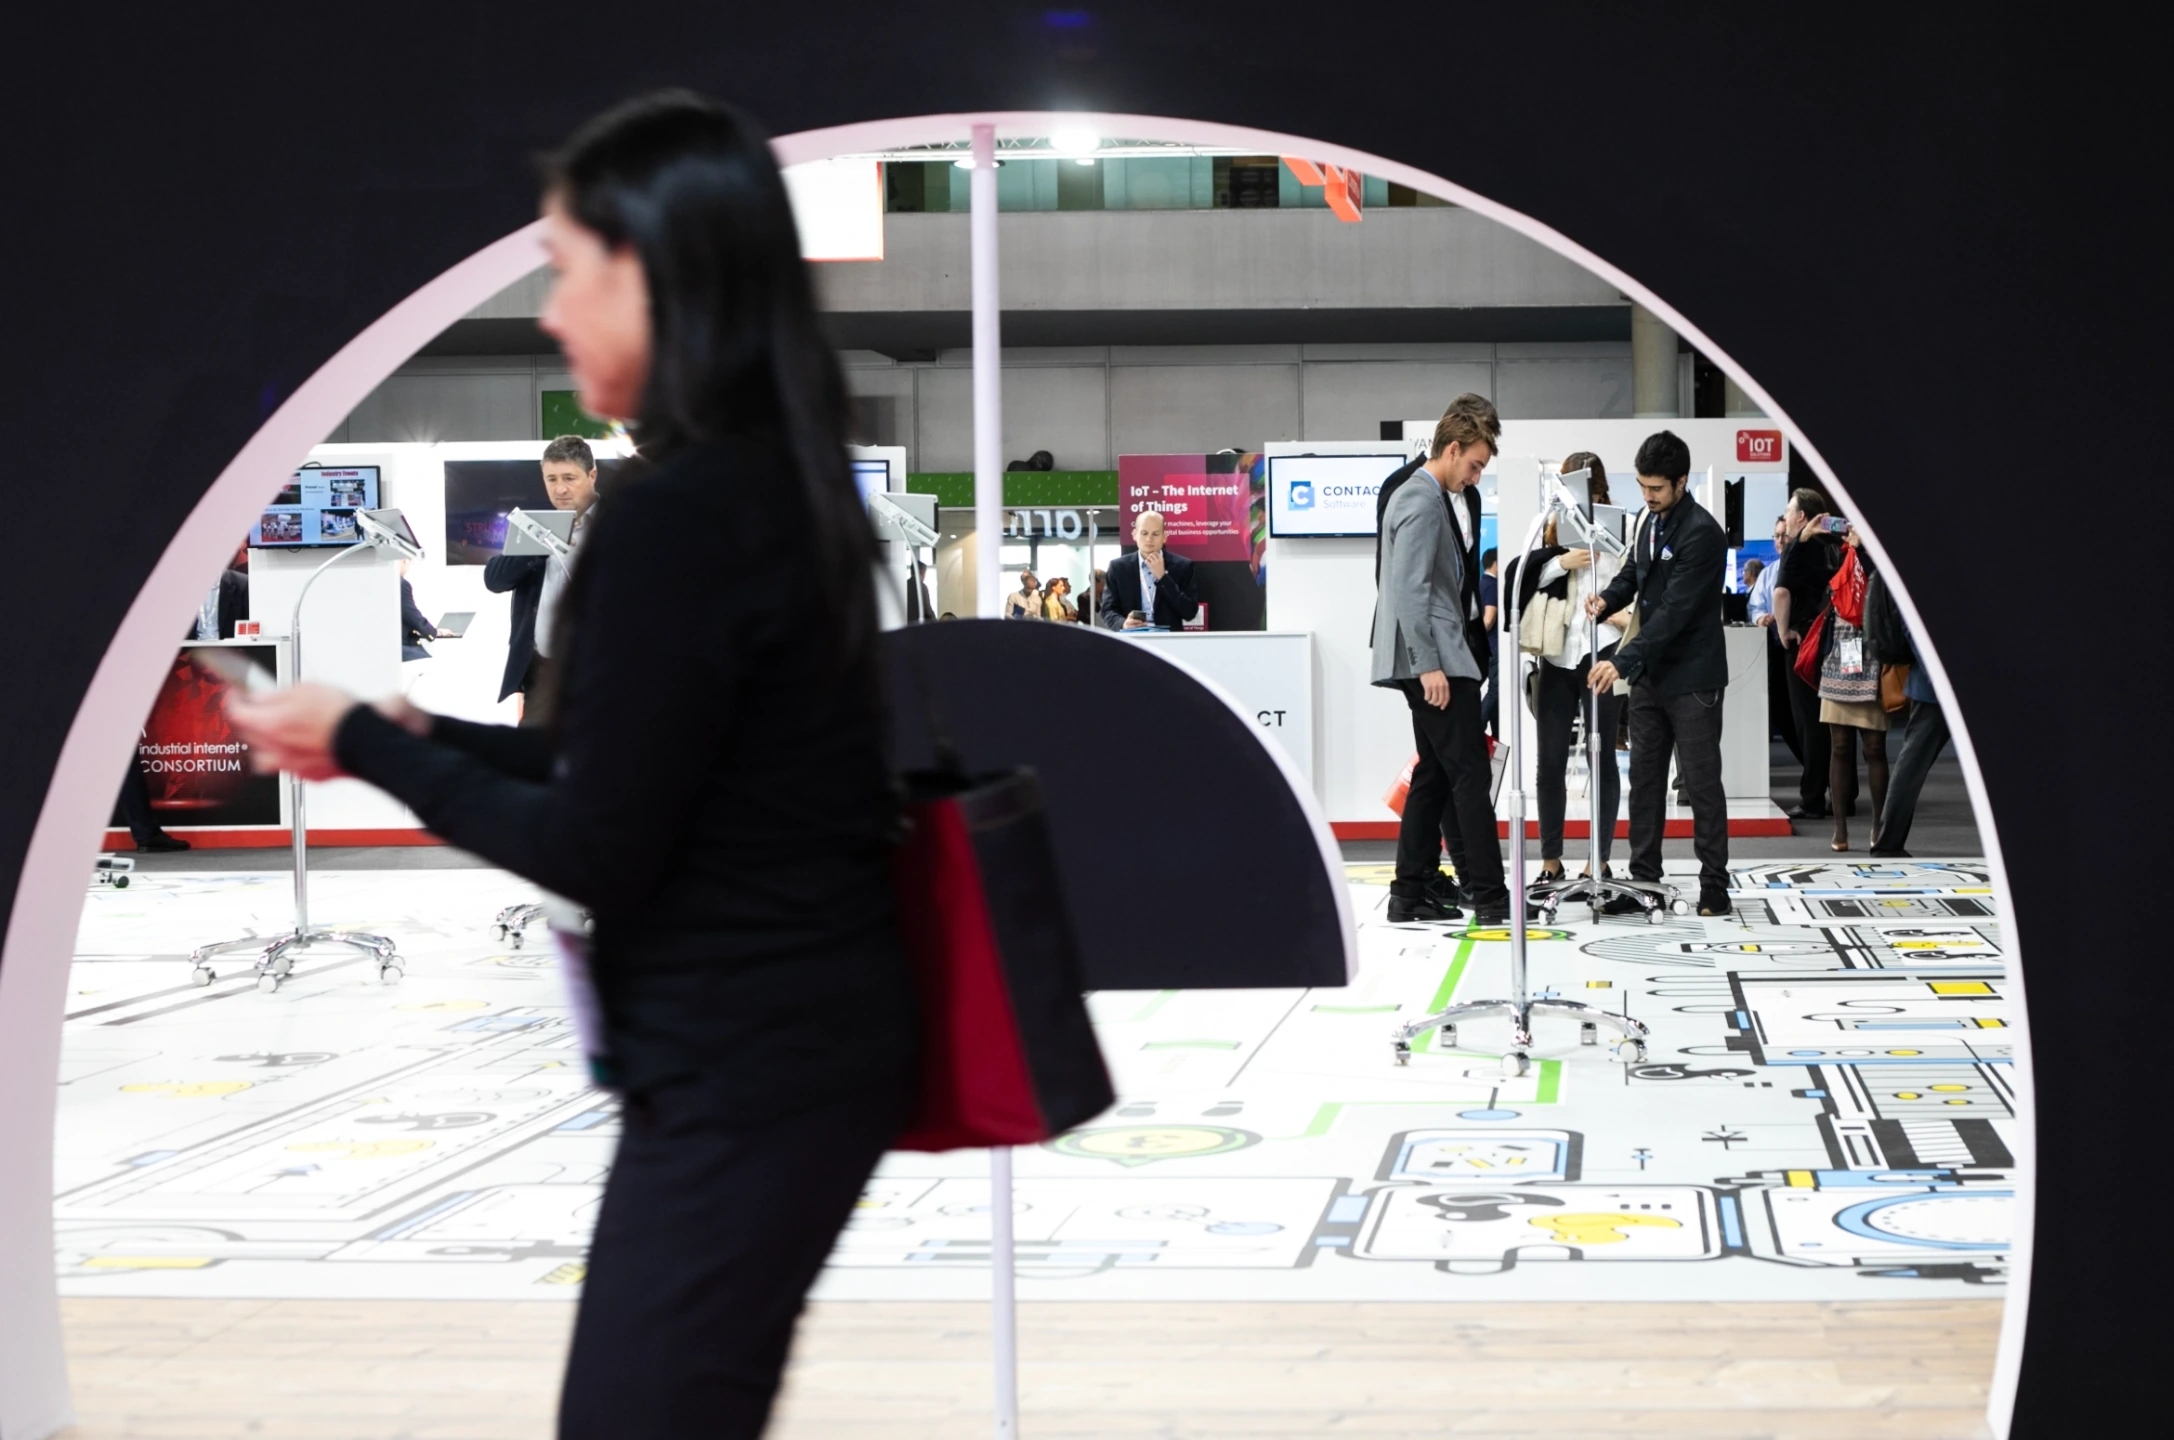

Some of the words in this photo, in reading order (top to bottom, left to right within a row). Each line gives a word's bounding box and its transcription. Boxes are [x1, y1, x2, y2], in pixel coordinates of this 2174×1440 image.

[1750, 438, 1774, 452] IOT
[1131, 486, 1149, 496] IoT
[1162, 485, 1185, 496] The
[1187, 485, 1239, 496] Internet
[1130, 501, 1144, 512] of
[1146, 501, 1188, 514] Things
[1323, 500, 1366, 508] Software
[139, 742, 191, 754] industrial
